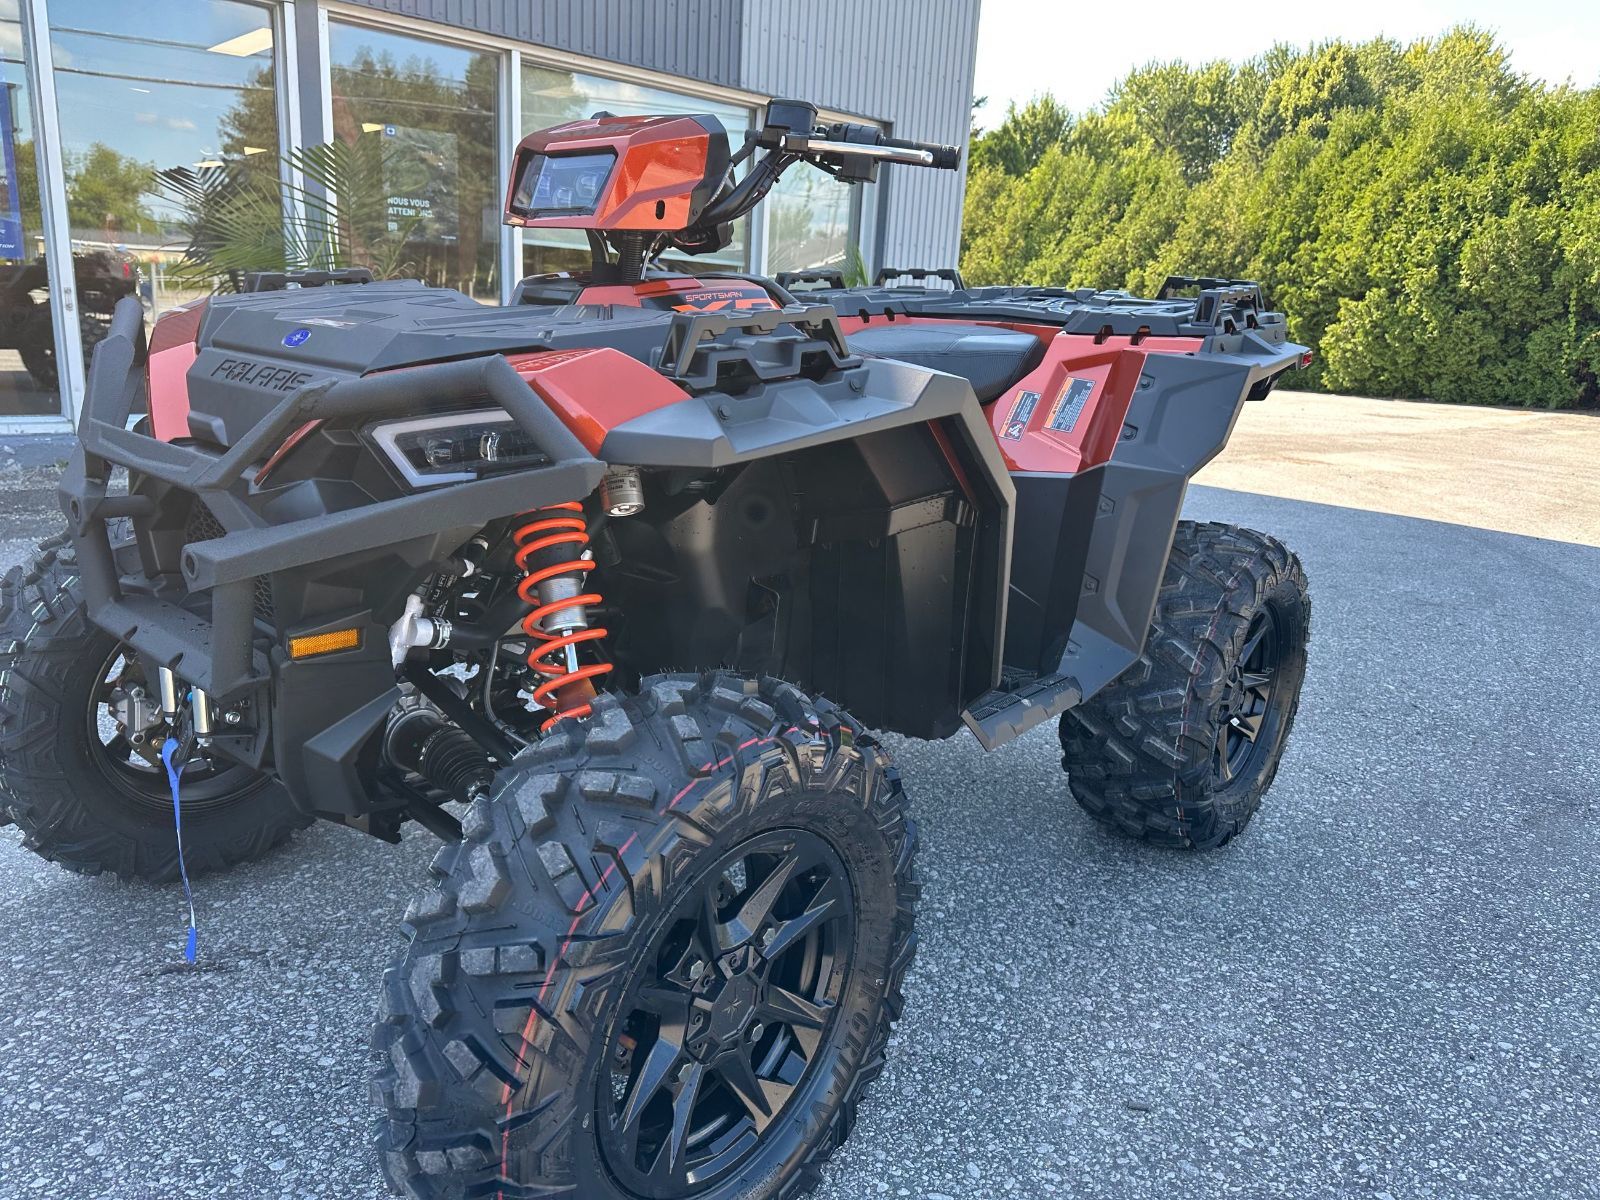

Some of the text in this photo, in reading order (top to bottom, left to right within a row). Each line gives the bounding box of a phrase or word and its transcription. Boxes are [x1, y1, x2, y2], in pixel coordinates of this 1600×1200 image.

[387, 197, 430, 207] NOUS VOUS
[388, 207, 435, 217] ATTENNS.
[685, 291, 743, 302] SPORTSMAN
[210, 359, 313, 391] POLARIS
